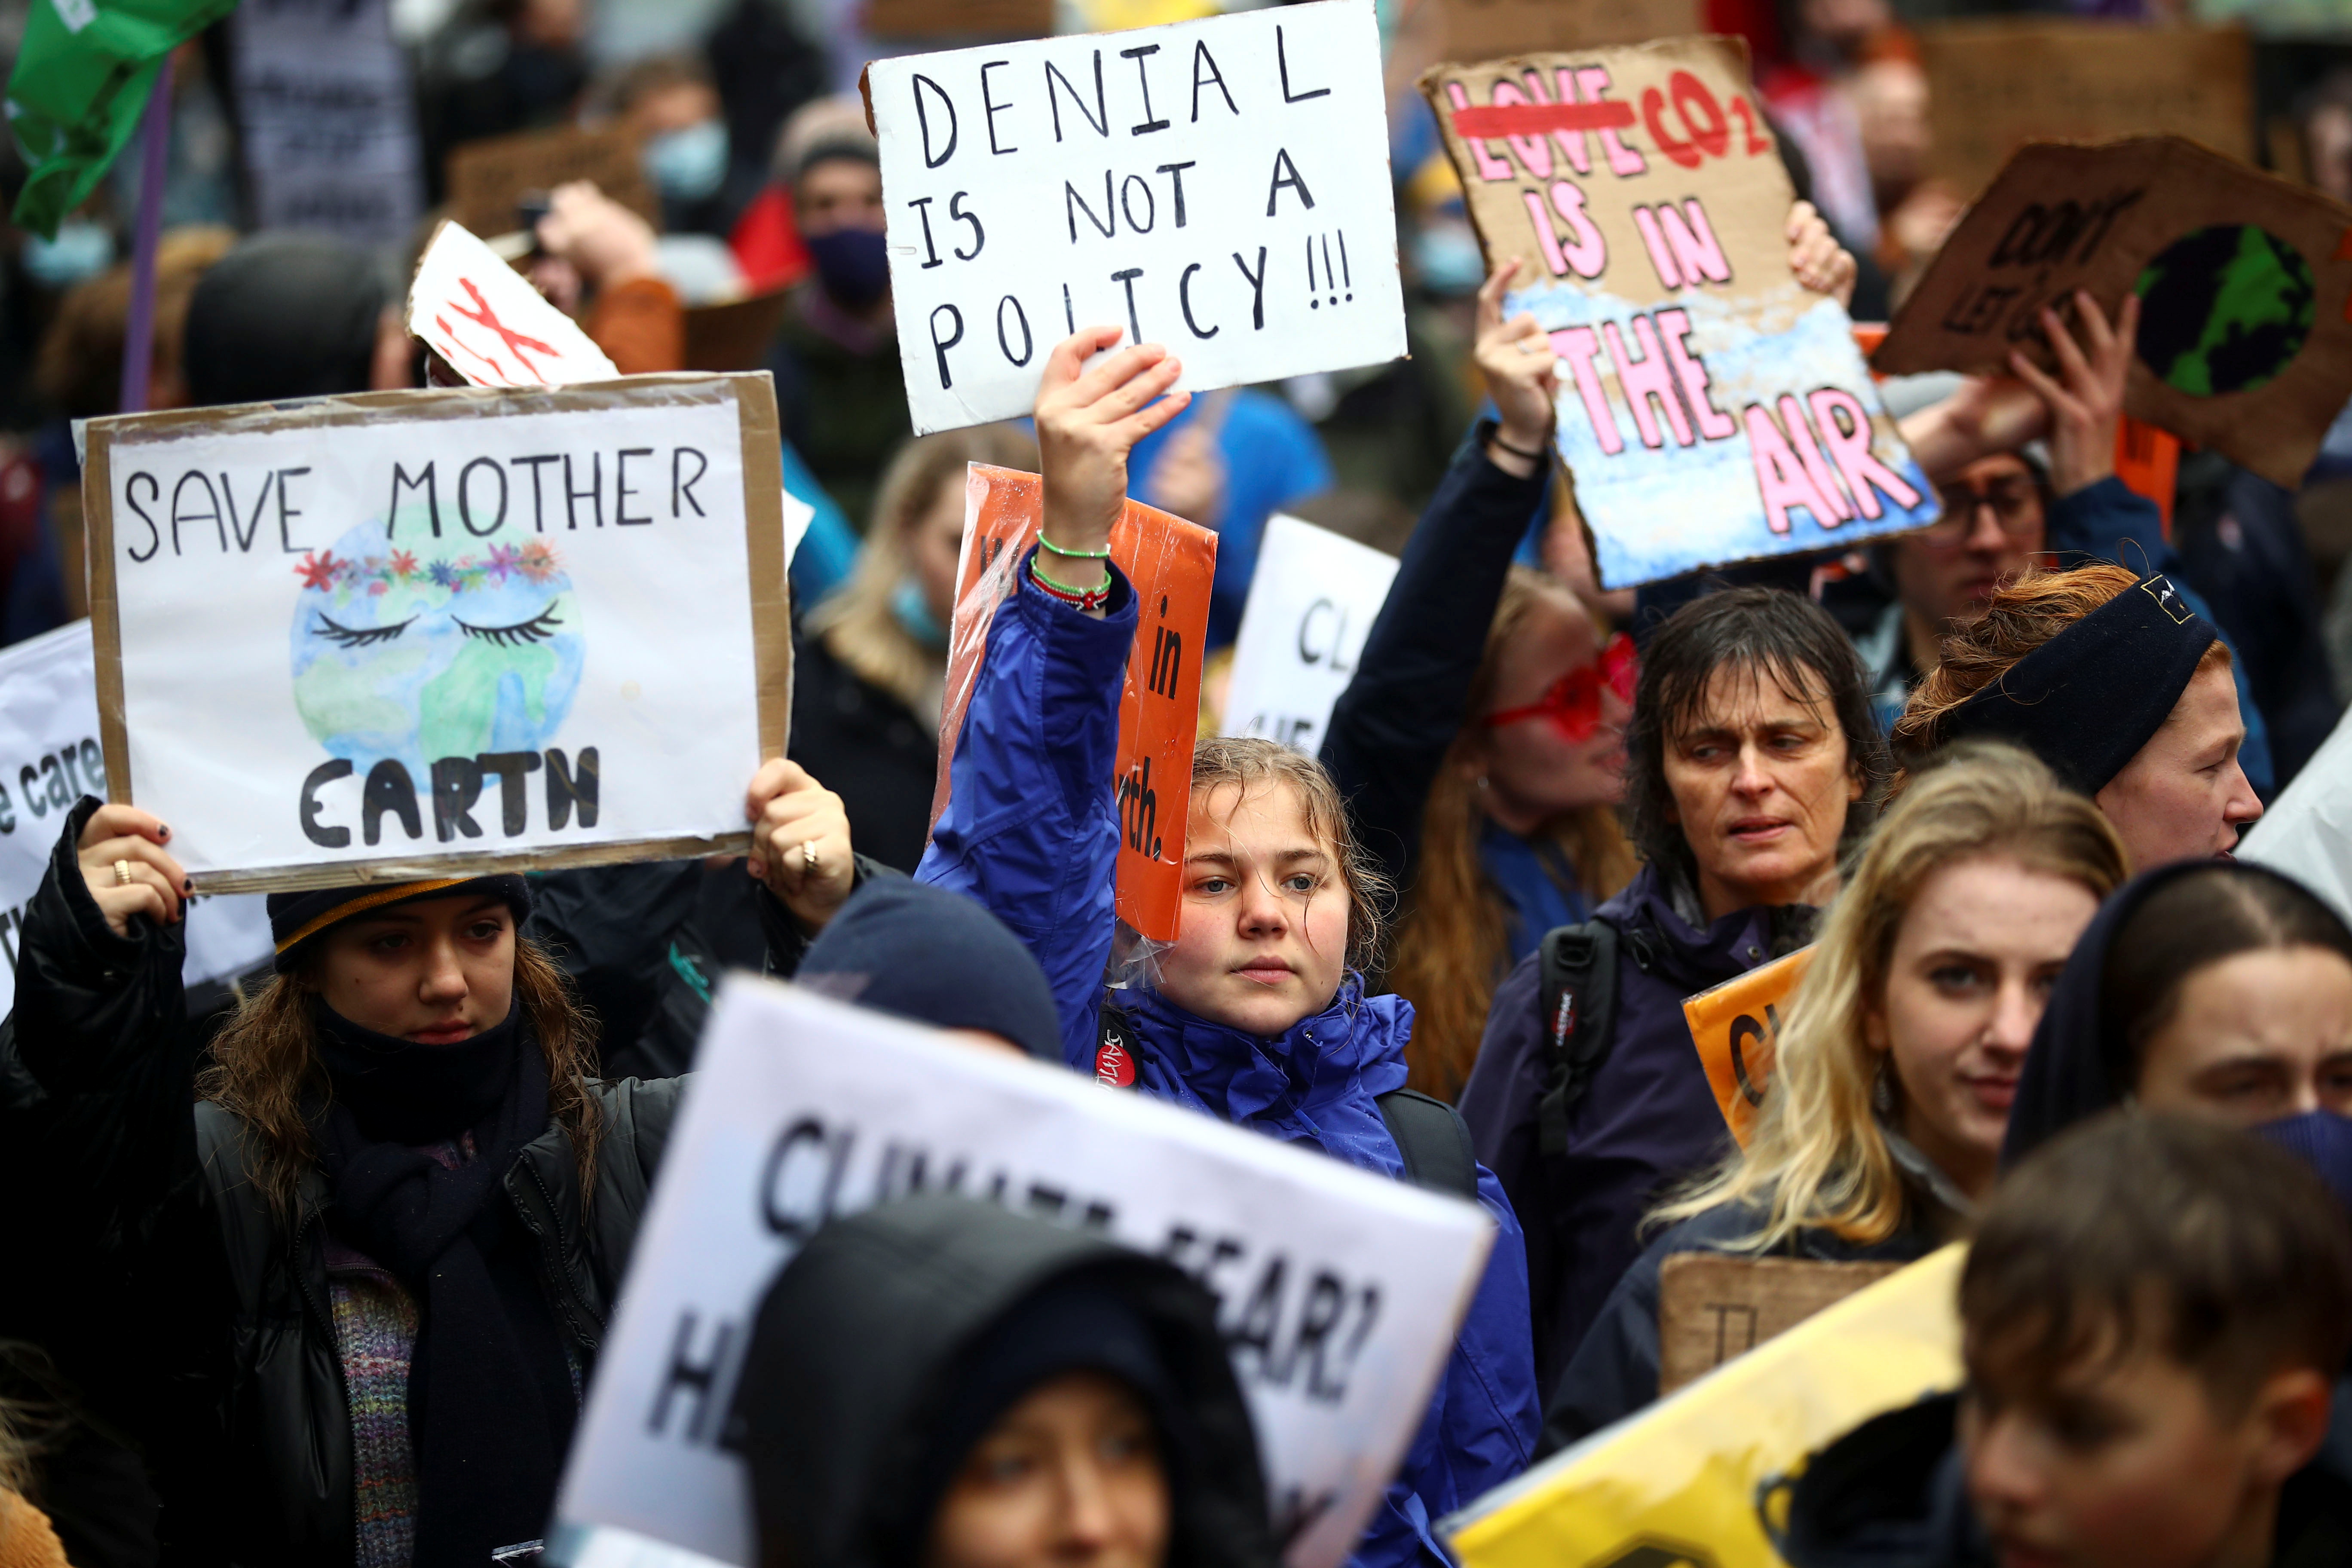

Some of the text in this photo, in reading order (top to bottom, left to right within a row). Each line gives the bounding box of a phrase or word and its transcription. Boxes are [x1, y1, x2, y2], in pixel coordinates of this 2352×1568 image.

[912, 24, 1331, 168] DENIAL
[908, 147, 1315, 270] IS NOT A
[1522, 178, 1732, 290] IS IN
[1547, 306, 1738, 456] THE
[126, 447, 709, 563] SAVE MOTHER
[1743, 386, 1921, 536] AIR
[1149, 594, 1182, 700] in
[19, 736, 107, 818] care
[300, 746, 600, 848] EARTH
[1112, 756, 1162, 862] rth.
